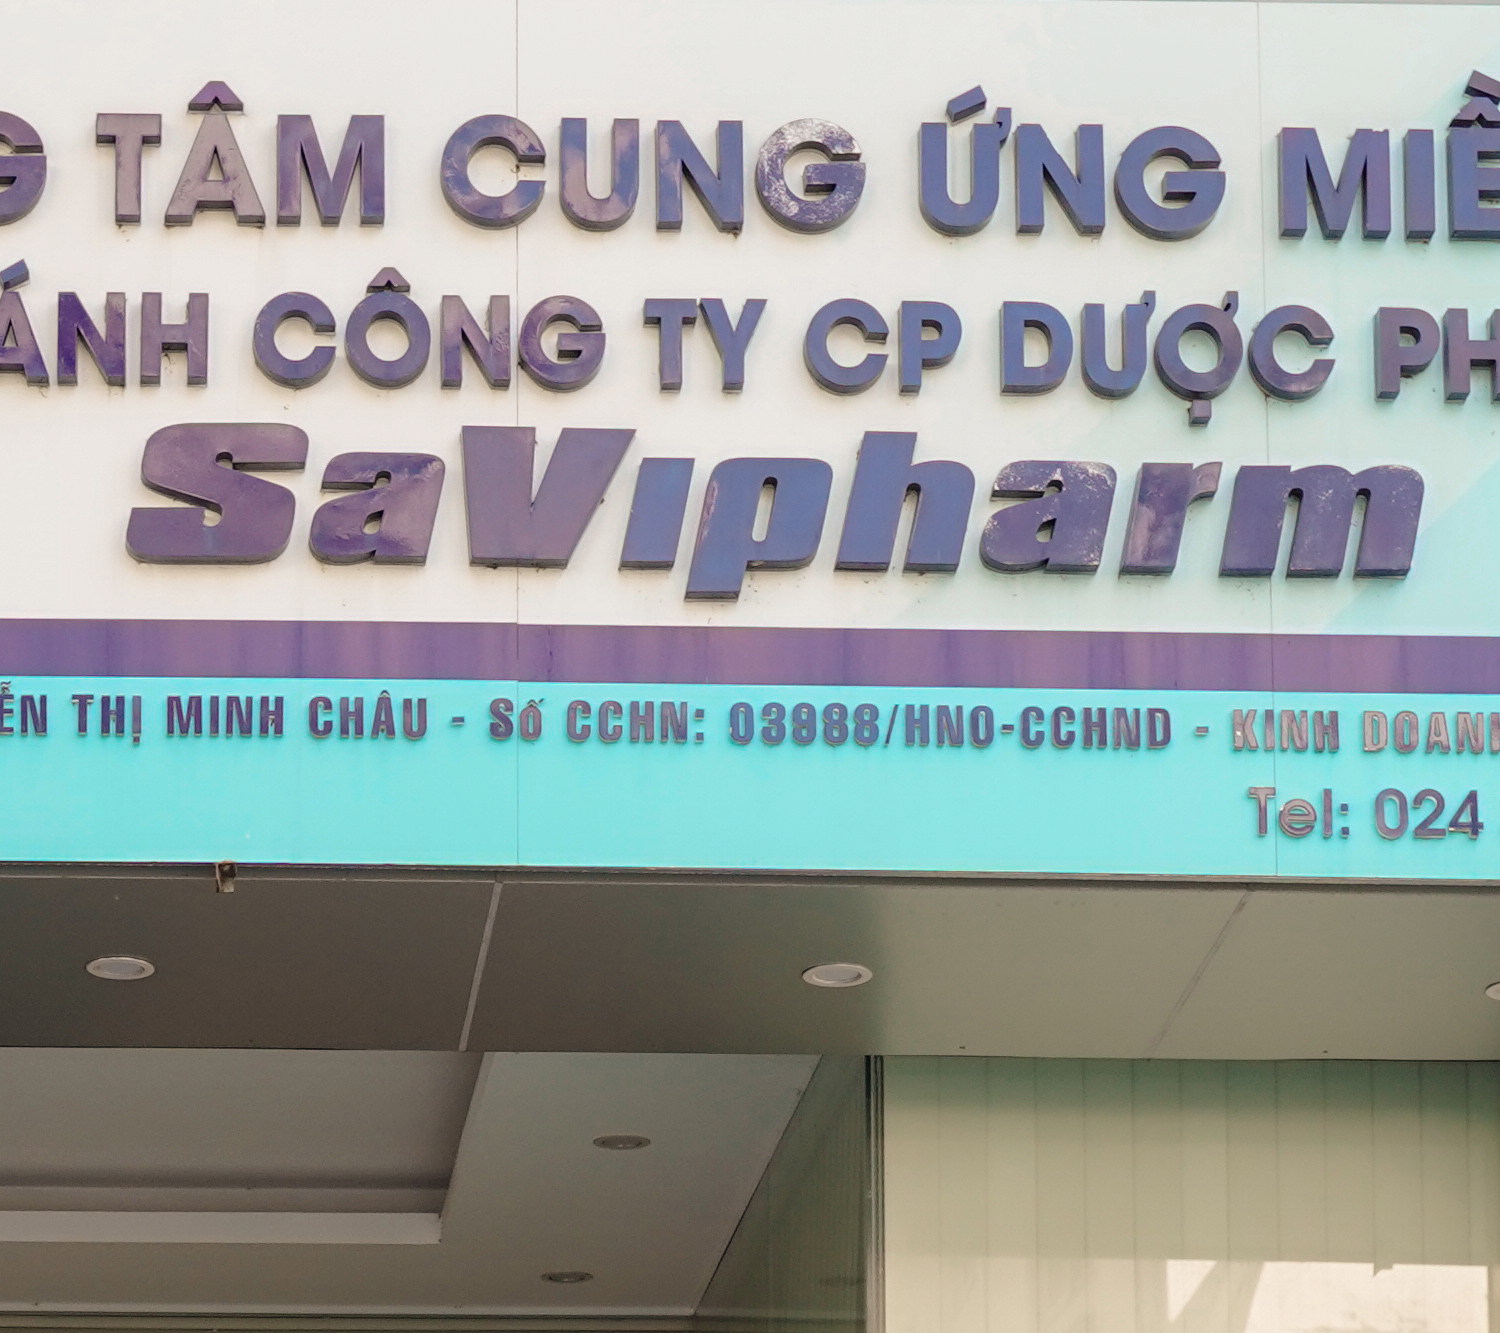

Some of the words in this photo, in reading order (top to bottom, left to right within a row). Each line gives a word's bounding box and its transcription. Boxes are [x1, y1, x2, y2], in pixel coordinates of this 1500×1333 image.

[95, 80, 386, 229] TÂM
[440, 113, 866, 235] CUNG
[917, 85, 1227, 241] ỨNG
[252, 266, 607, 392] CÔNG
[644, 297, 767, 395] TY
[803, 298, 961, 398] CP
[1000, 291, 1336, 427] DƯỢC
[125, 423, 1426, 602] SaVipharm
[71, 693, 143, 744] THỊ
[166, 694, 286, 739] MINH
[308, 690, 429, 740] CHÂU
[566, 698, 706, 746] CCHN:
[729, 702, 1172, 750] 03988/HNO-CCHND
[1231, 707, 1341, 753] KINH
[1247, 785, 1352, 840] Tel:
[1373, 787, 1485, 841] 024
